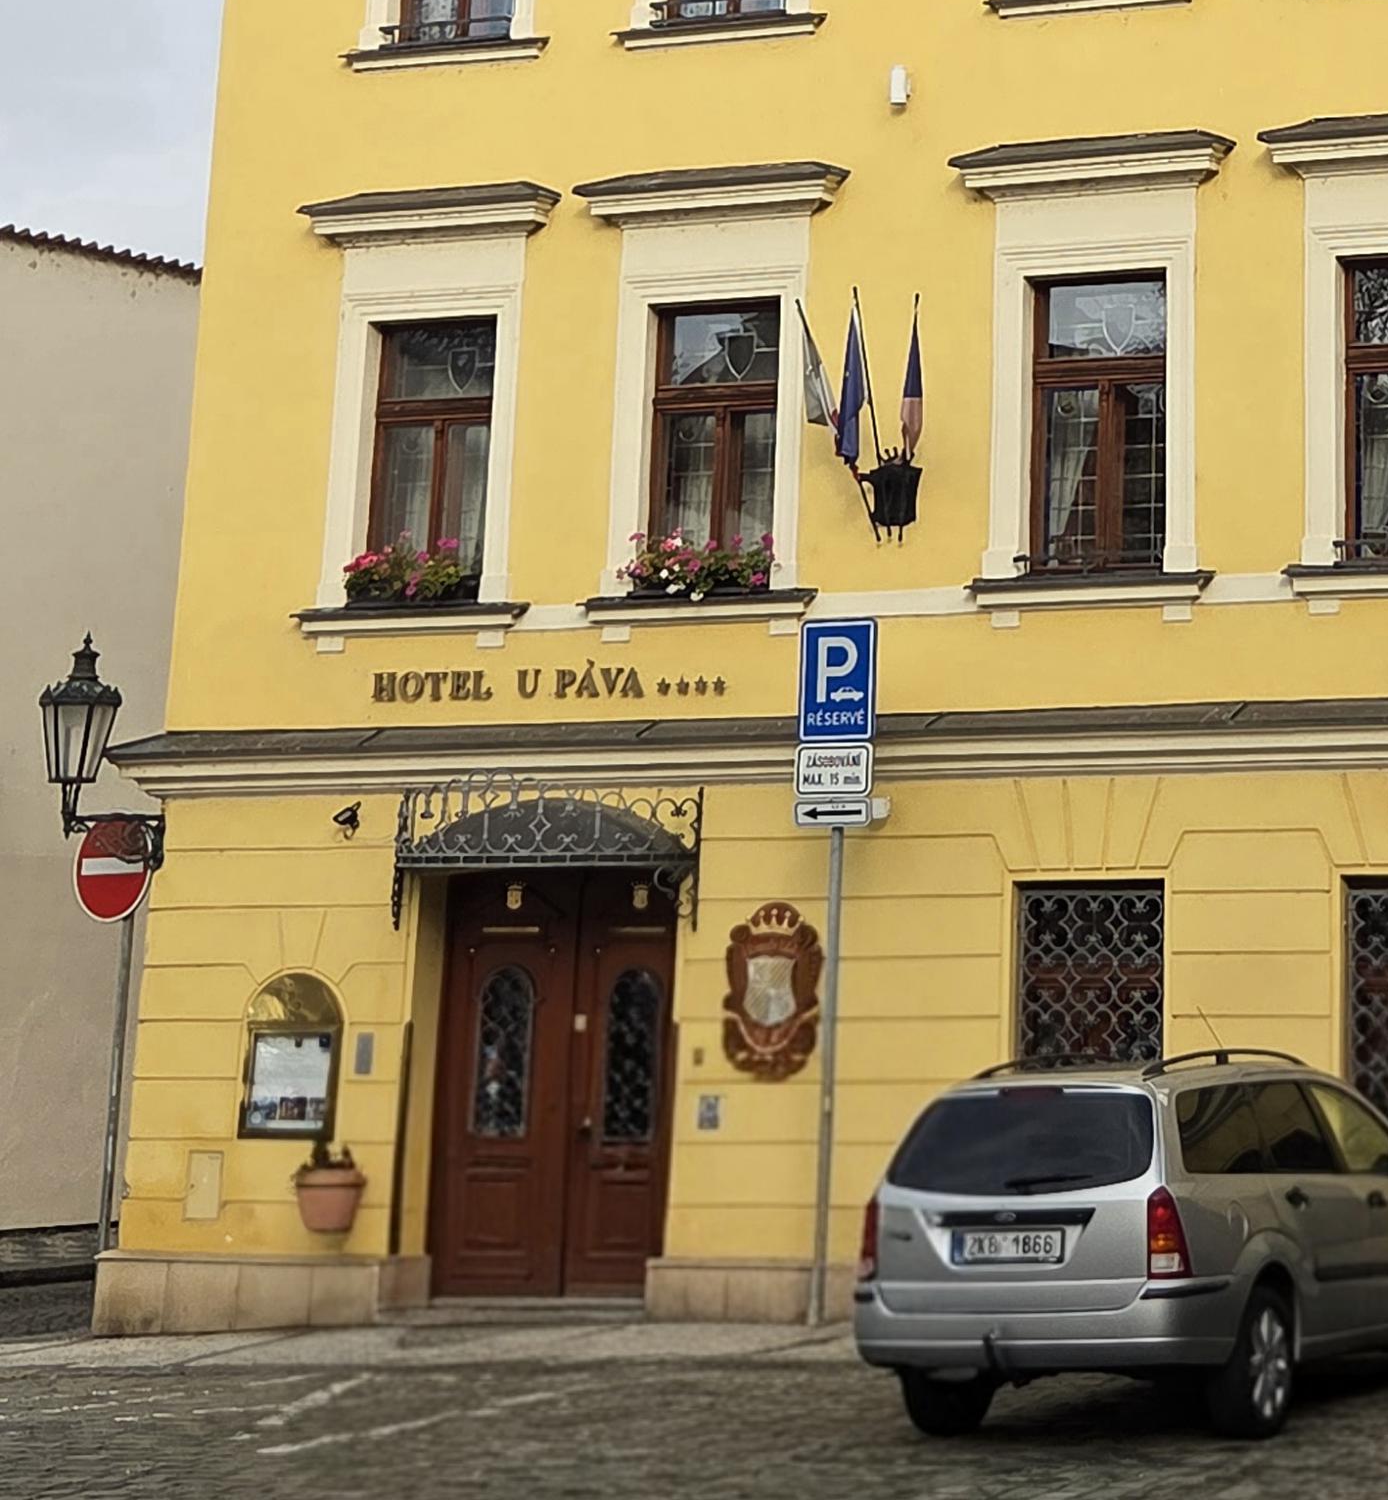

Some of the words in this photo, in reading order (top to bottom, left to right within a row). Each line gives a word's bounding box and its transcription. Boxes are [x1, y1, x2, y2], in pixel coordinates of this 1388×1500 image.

[371, 670, 494, 703] HOTEL
[517, 669, 541, 699] U
[816, 636, 858, 703] P
[807, 708, 865, 726] RÉSERVÉ
